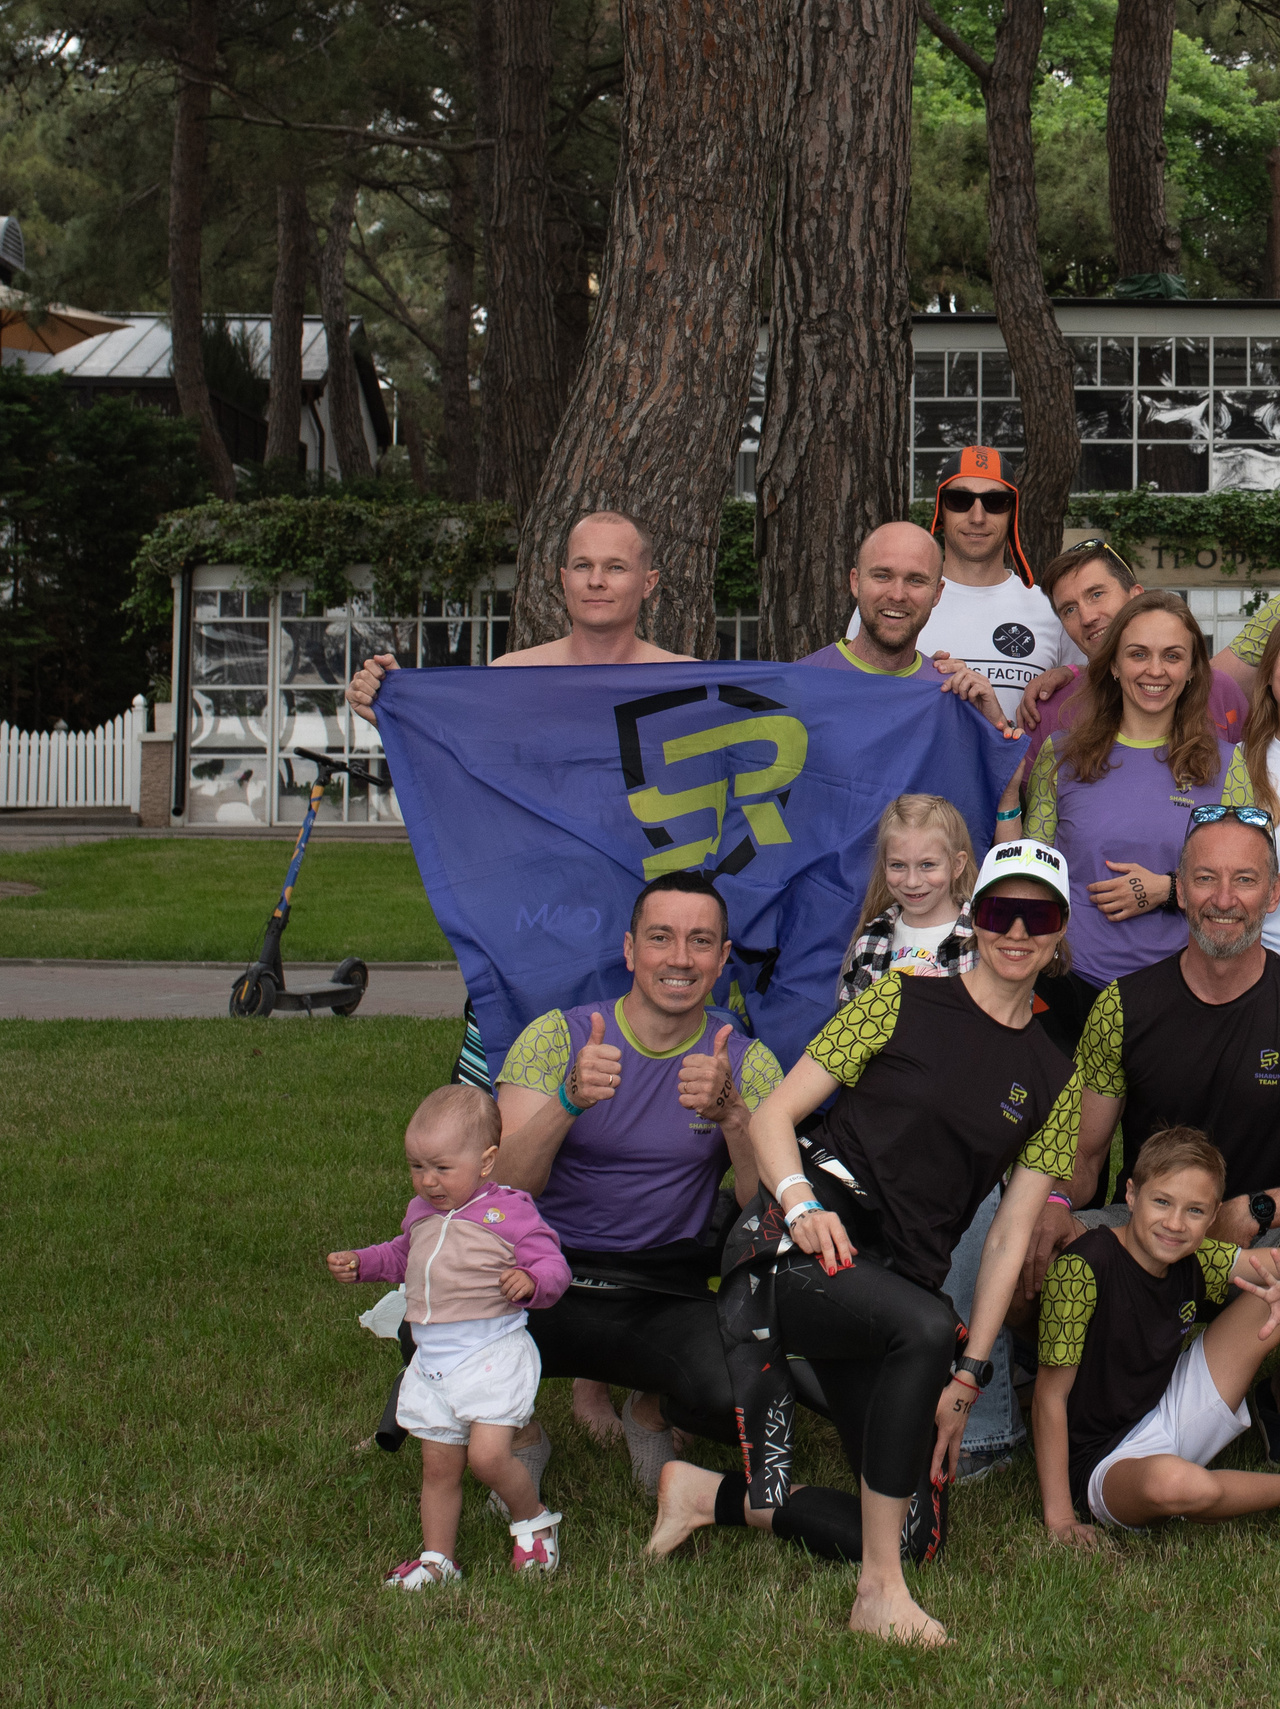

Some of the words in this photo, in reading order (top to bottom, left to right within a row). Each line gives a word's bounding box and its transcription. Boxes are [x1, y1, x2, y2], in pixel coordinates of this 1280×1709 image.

[996, 846, 1022, 861] IRON
[1036, 848, 1060, 871] STAR
[1128, 877, 1150, 909] 6036
[1002, 1109, 1018, 1124] TEAM
